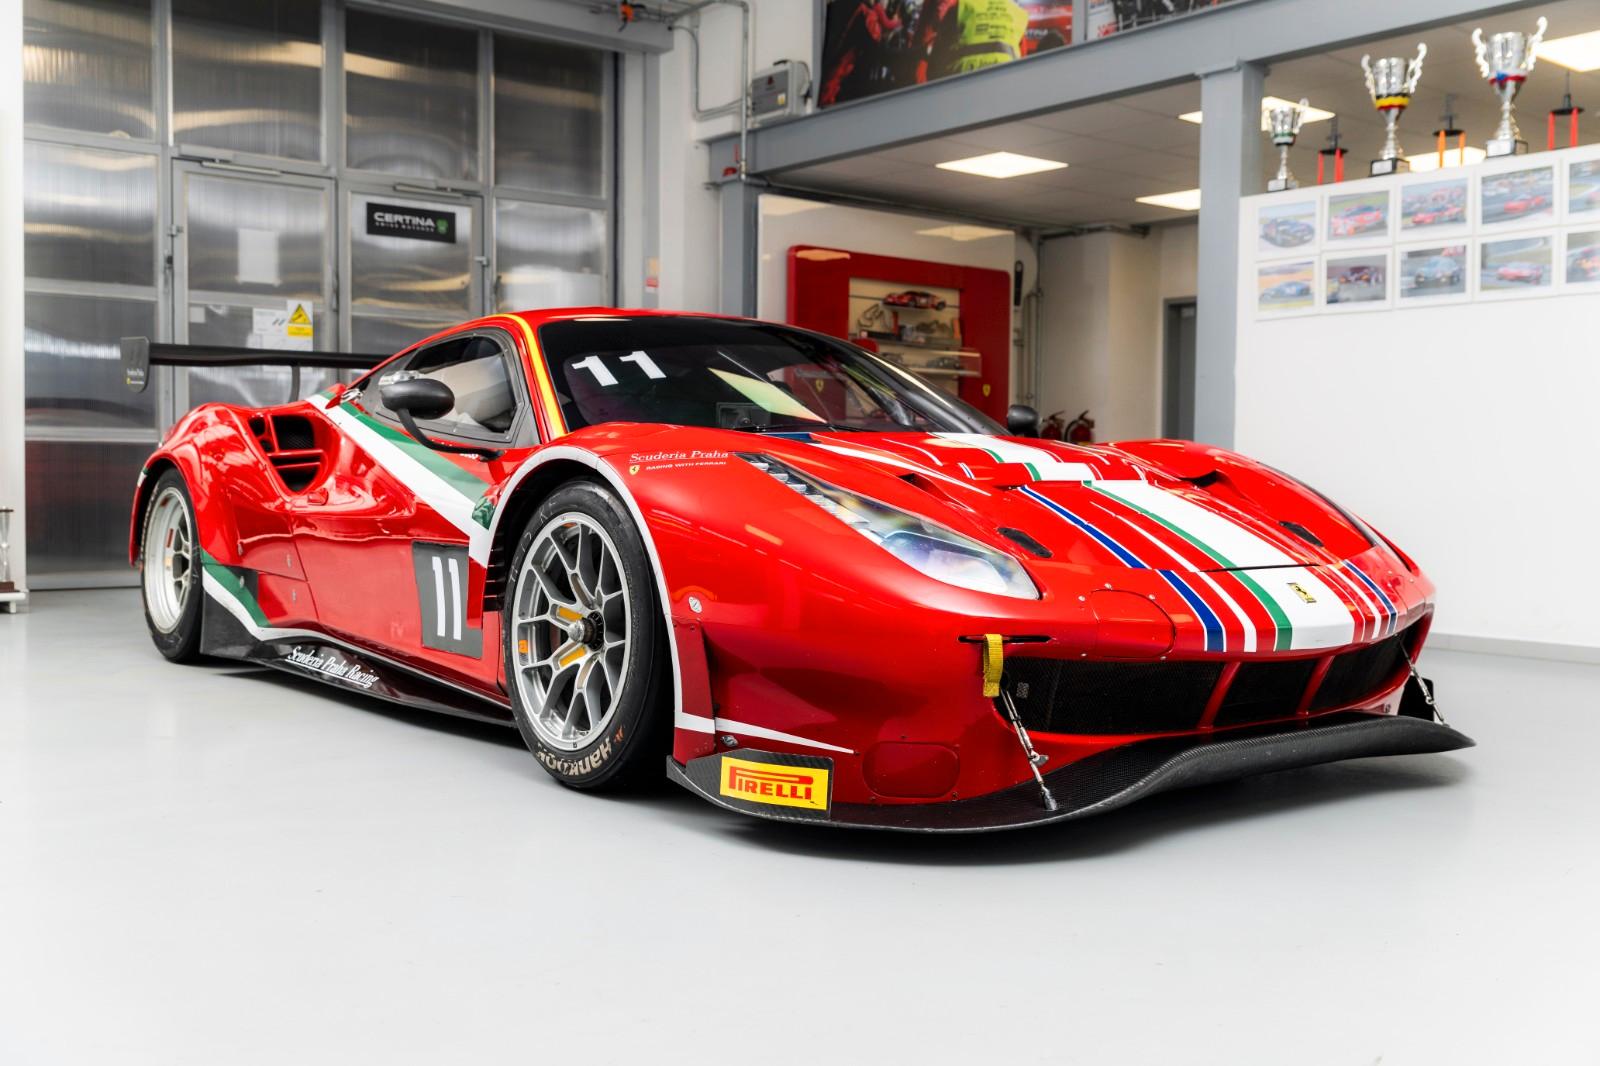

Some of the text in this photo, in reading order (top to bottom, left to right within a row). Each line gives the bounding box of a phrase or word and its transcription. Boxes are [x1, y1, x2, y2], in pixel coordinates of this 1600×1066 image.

[374, 212, 435, 227] CERTINA
[571, 350, 667, 387] 11
[629, 450, 729, 462] Scuderia Praha
[645, 463, 673, 471] RACING
[431, 556, 462, 641] 11
[285, 645, 379, 688] Scuderia Praha Racing
[728, 765, 814, 801] PIRELLI
